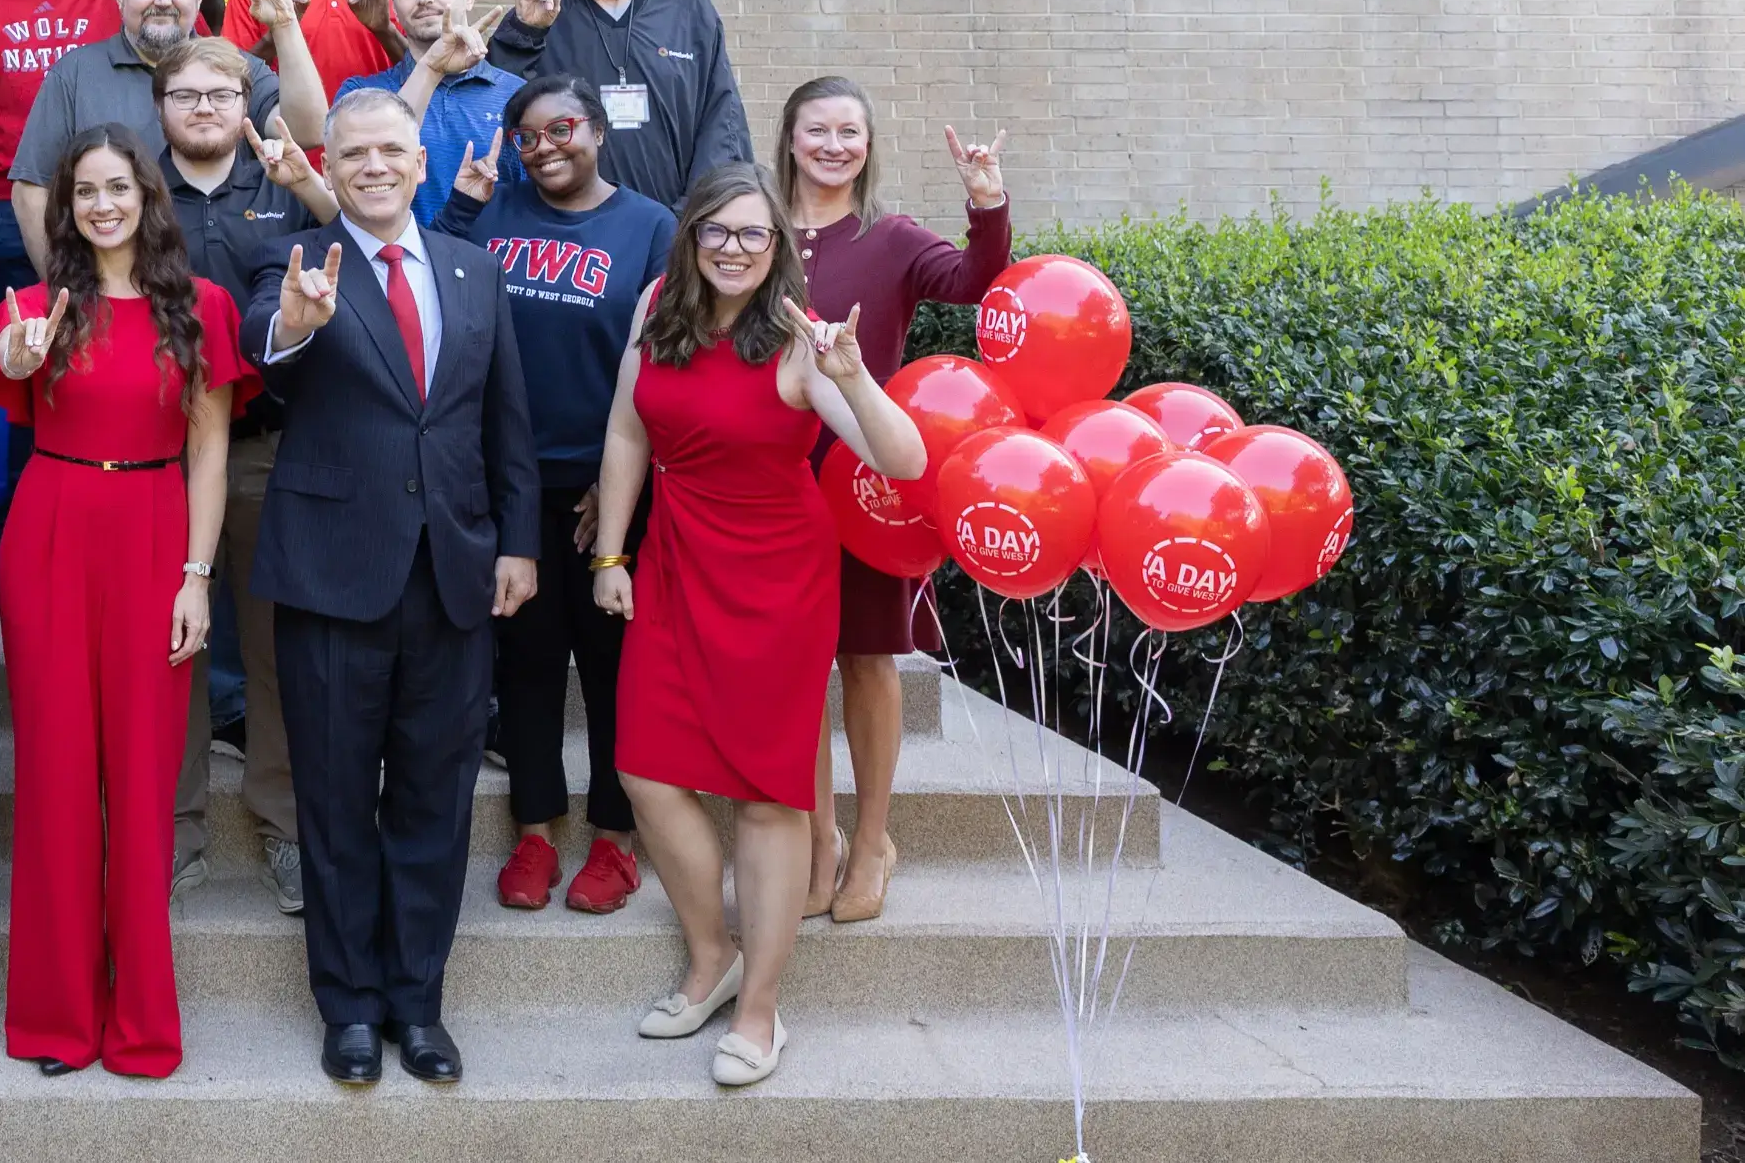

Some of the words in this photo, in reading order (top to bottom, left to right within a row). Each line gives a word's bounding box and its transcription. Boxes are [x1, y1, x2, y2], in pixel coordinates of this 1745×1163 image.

[2, 17, 89, 44] WOLF
[1, 43, 87, 73] NATI
[525, 287, 537, 298] OF
[538, 290, 561, 301] WEST
[562, 293, 594, 308] GEORGIA
[986, 308, 1022, 335] DAY
[994, 331, 1016, 345] WEST
[859, 477, 878, 502] A
[868, 498, 881, 510] TO
[881, 493, 903, 507] GIVE
[961, 521, 977, 545] A
[984, 526, 1034, 553] DAY
[1324, 533, 1340, 555] A
[965, 542, 977, 554] TO
[979, 546, 1000, 559] GIVE
[1001, 550, 1030, 562] WEST
[1147, 555, 1167, 581] A
[1177, 563, 1232, 593] DAY
[1151, 577, 1165, 589] TO
[1167, 583, 1191, 596] GIVE
[1192, 589, 1222, 602] WEST
